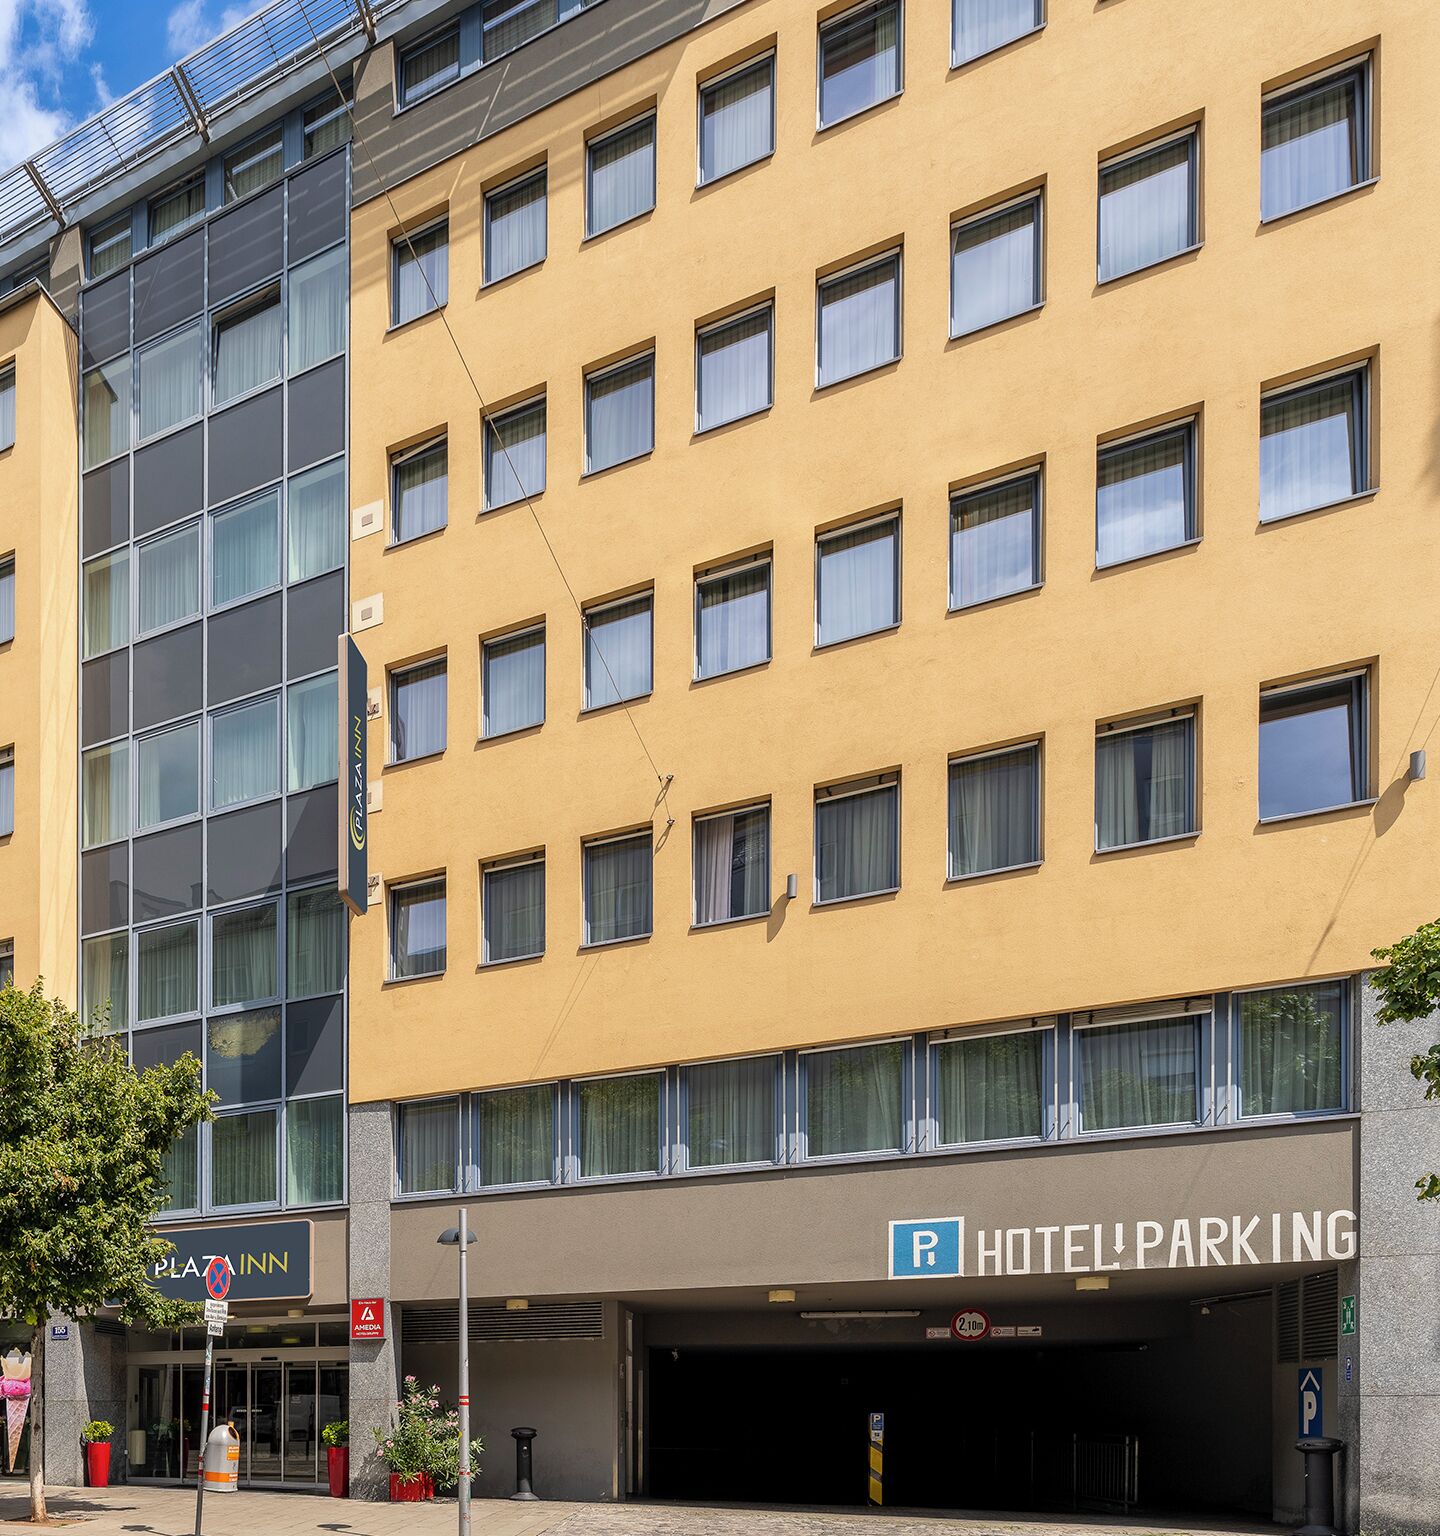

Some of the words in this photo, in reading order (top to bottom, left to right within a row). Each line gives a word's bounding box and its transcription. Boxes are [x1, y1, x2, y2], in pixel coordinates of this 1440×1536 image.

[354, 715, 362, 759] INN
[354, 763, 363, 831] PLAZA
[240, 1251, 288, 1275] INN
[912, 1230, 939, 1268] P
[977, 1222, 1121, 1277] HOTEL
[1136, 1208, 1358, 1270] PARKING
[1303, 1391, 1317, 1435] P
